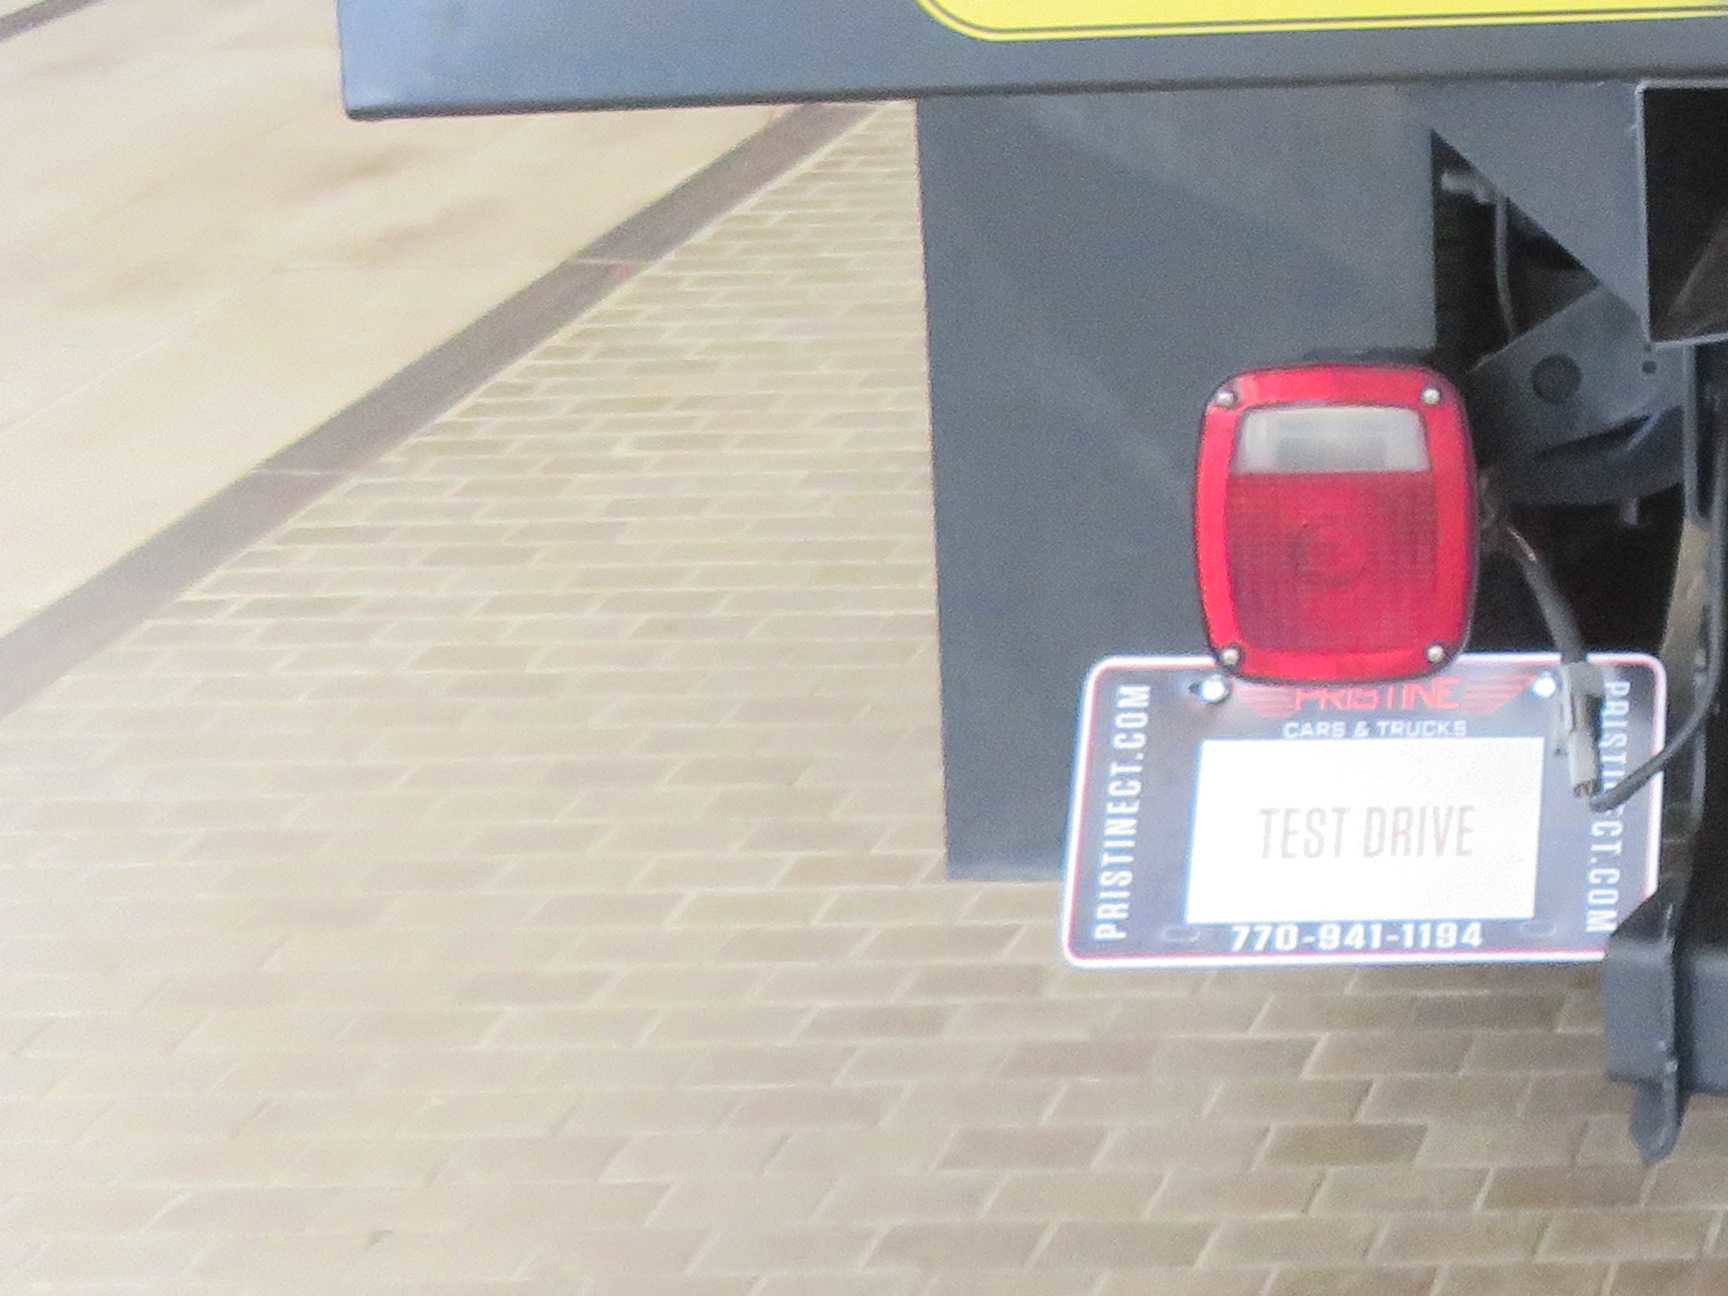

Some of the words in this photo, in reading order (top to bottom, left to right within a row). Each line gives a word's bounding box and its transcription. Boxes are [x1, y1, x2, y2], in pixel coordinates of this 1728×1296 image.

[1282, 720, 1346, 740] CARS
[1353, 720, 1371, 738] &
[1375, 718, 1468, 738] TRUCKS
[1093, 684, 1151, 942] PRISTINECT.COM
[1258, 806, 1351, 859] TEST
[1363, 804, 1476, 858] DRIVE
[1585, 679, 1632, 934] PRISTICT.COM
[1230, 921, 1484, 952] 770-941-1194
